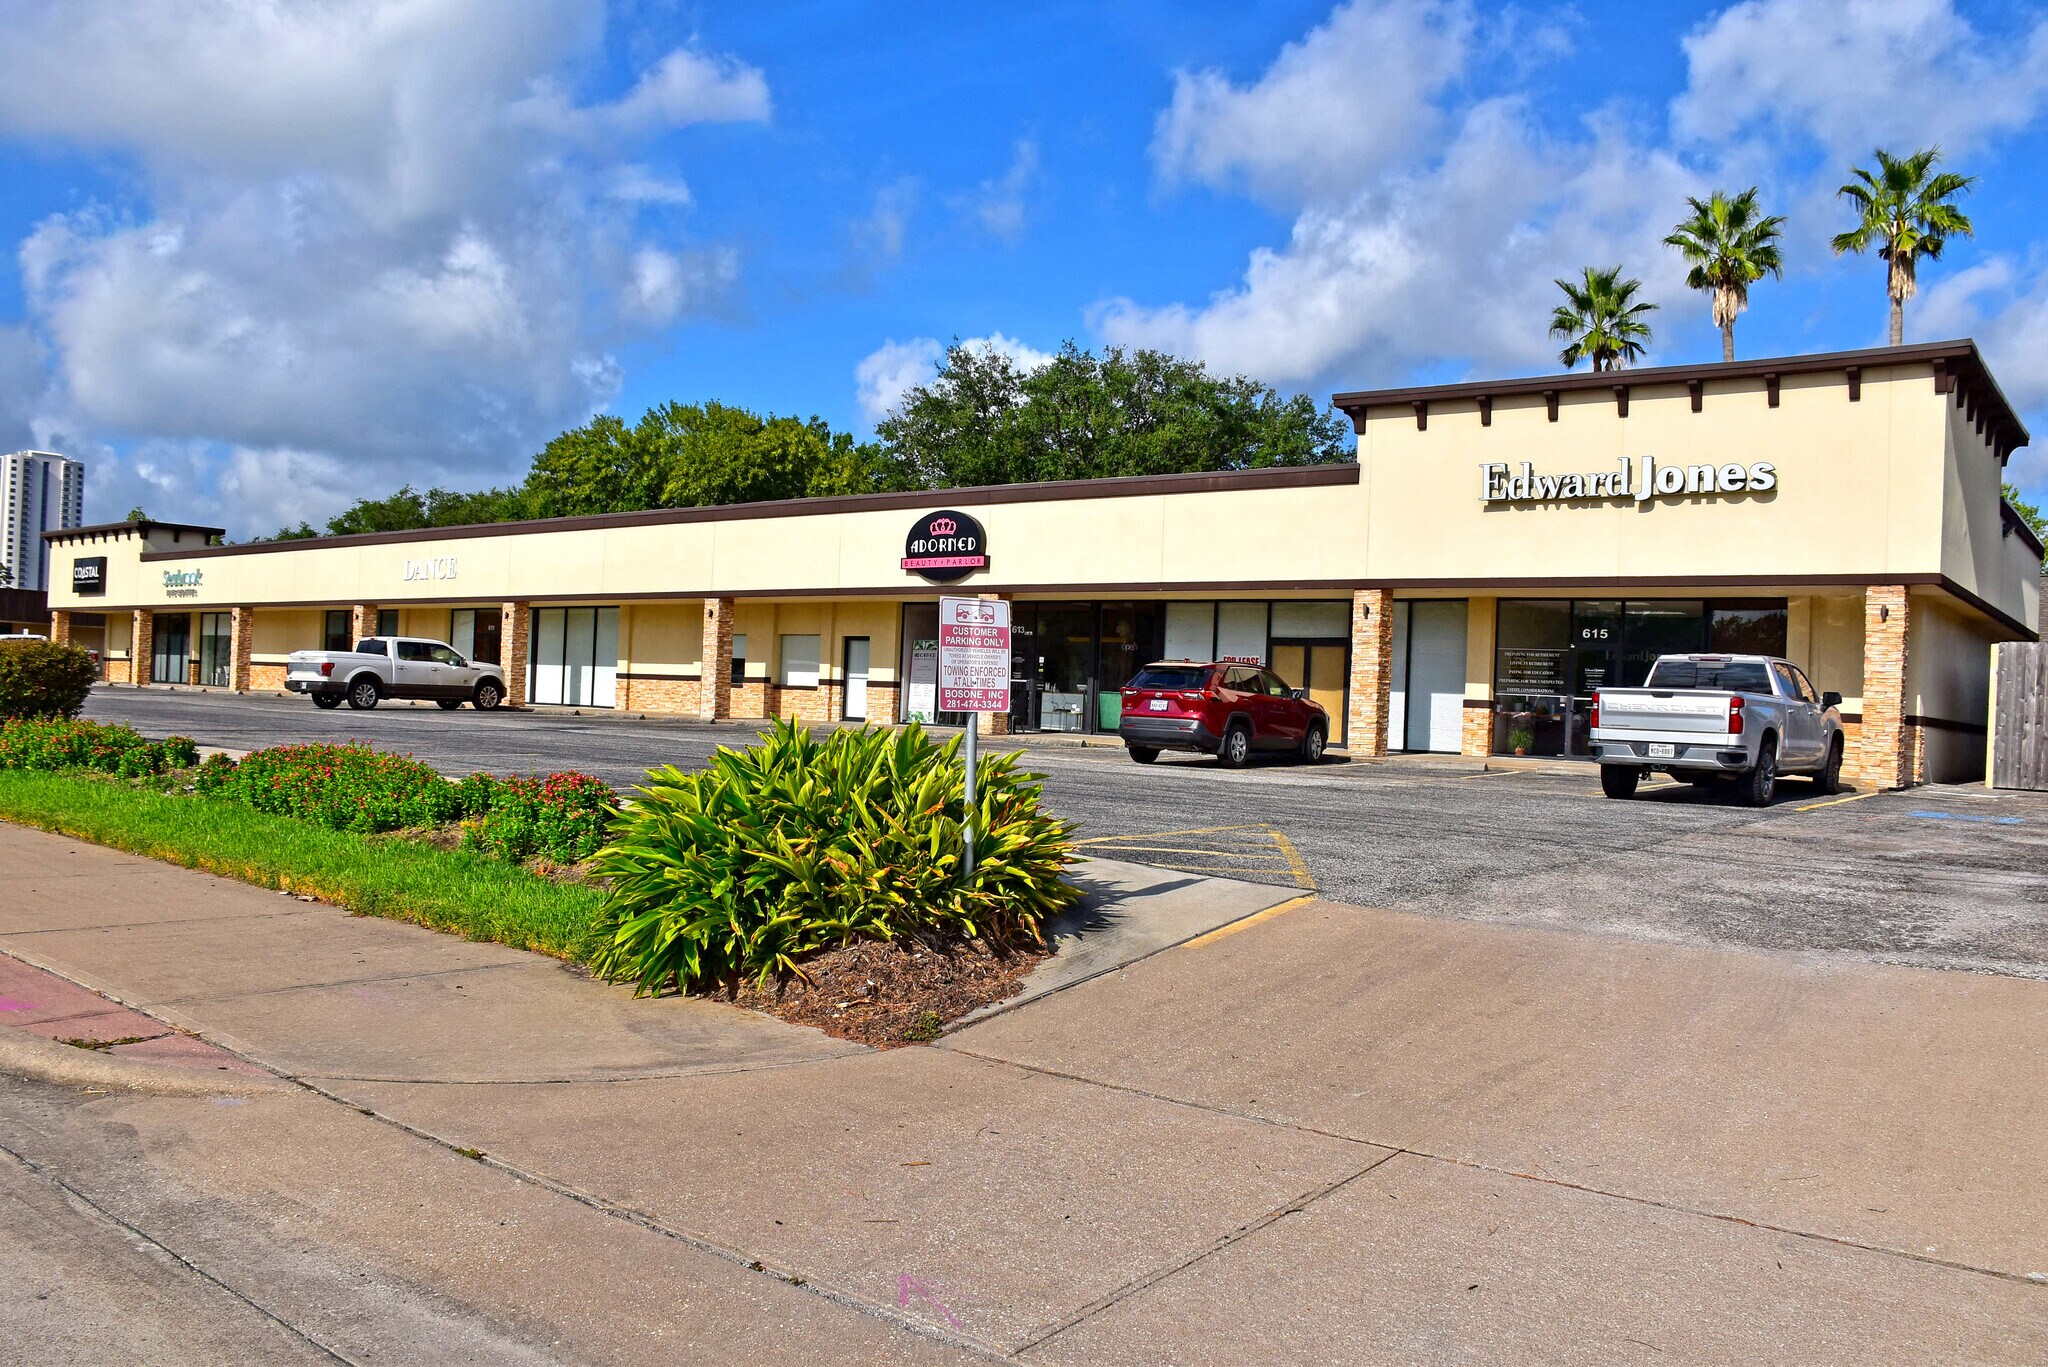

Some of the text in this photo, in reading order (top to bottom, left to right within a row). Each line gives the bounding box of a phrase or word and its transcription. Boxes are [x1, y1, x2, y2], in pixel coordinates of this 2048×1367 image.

[1478, 455, 1777, 501] Edward Jones
[910, 537, 976, 553] ADORNED
[904, 557, 982, 567] BEAUTY PARLOR
[74, 566, 99, 579] COASTAL
[403, 557, 458, 581] DANCE
[952, 626, 998, 637] CUSTOMER
[1011, 625, 1025, 634] 613
[1582, 628, 1609, 639] 615
[945, 636, 1005, 647] PARKING ONLY
[943, 665, 969, 677] TOWING
[970, 666, 1007, 678] ENFORCED
[953, 676, 996, 688] AT ALL TIMES
[945, 689, 986, 700] BOSONE,
[988, 690, 1004, 699] INC
[946, 699, 1002, 709] 281-474-3344
[1606, 702, 1720, 713] CHEVROLET
